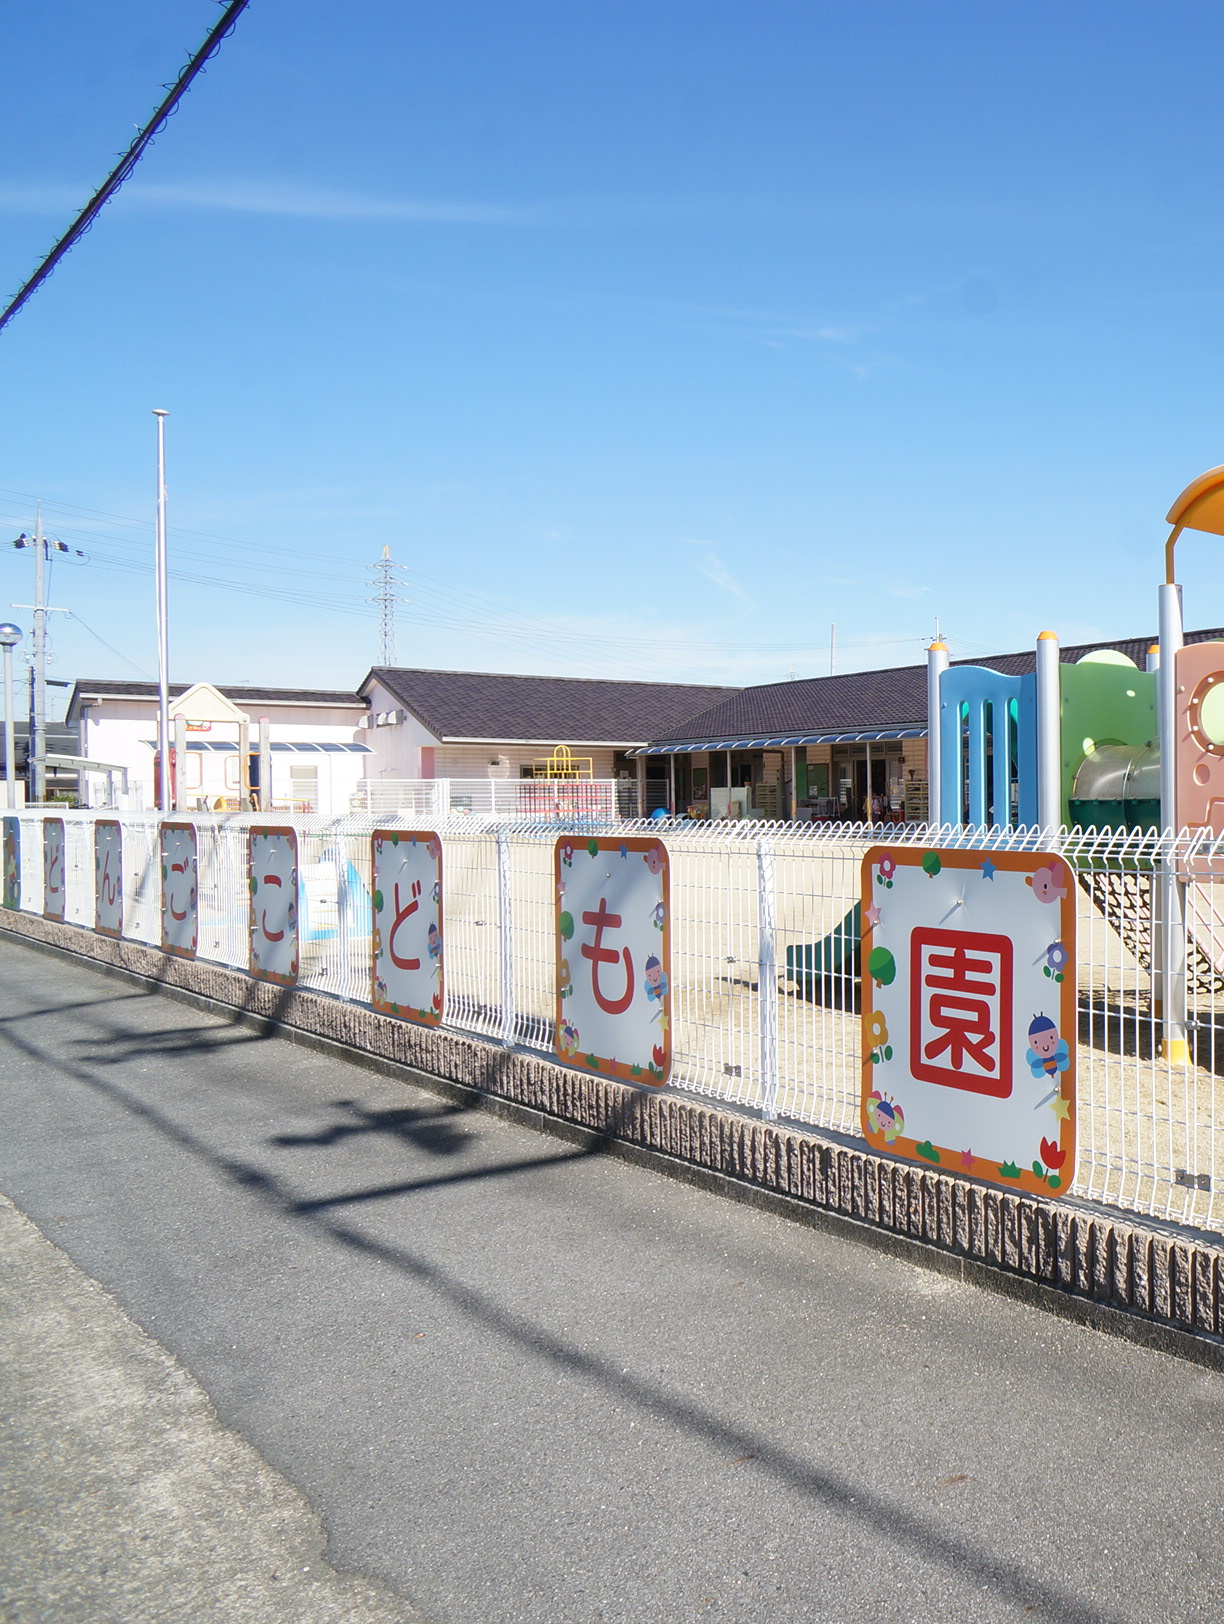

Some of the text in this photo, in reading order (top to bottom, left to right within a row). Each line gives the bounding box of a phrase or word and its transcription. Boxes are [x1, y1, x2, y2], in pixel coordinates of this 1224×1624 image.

[101, 850, 116, 906] ん
[170, 857, 189, 921] ご
[262, 874, 285, 942] こ
[389, 879, 422, 971] ど
[581, 897, 636, 1015] も
[910, 926, 1014, 1099] 園
